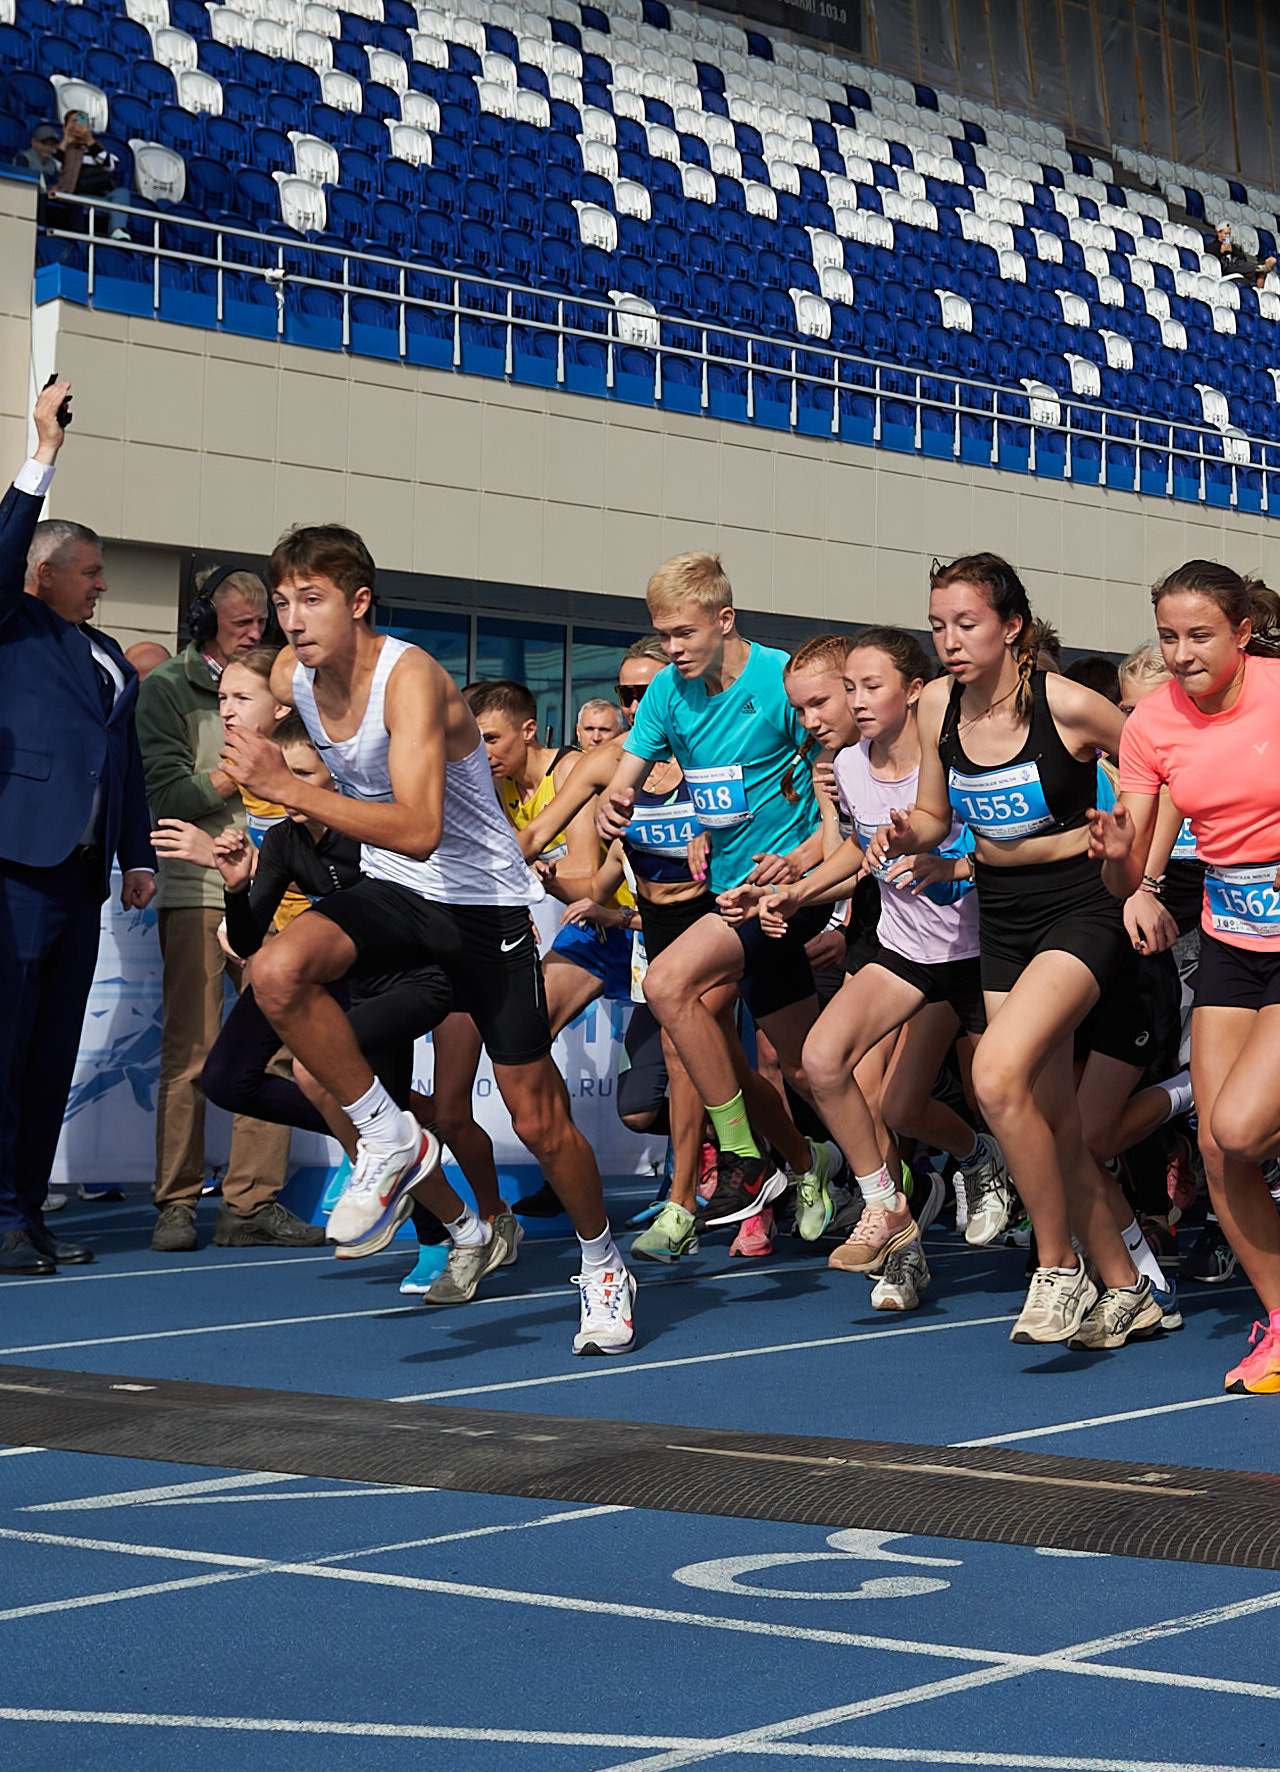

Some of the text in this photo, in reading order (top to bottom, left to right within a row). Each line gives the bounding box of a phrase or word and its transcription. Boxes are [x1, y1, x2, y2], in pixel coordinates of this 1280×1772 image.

[693, 786, 732, 810] 618
[961, 791, 1029, 821] 1553
[635, 822, 695, 844] 1514
